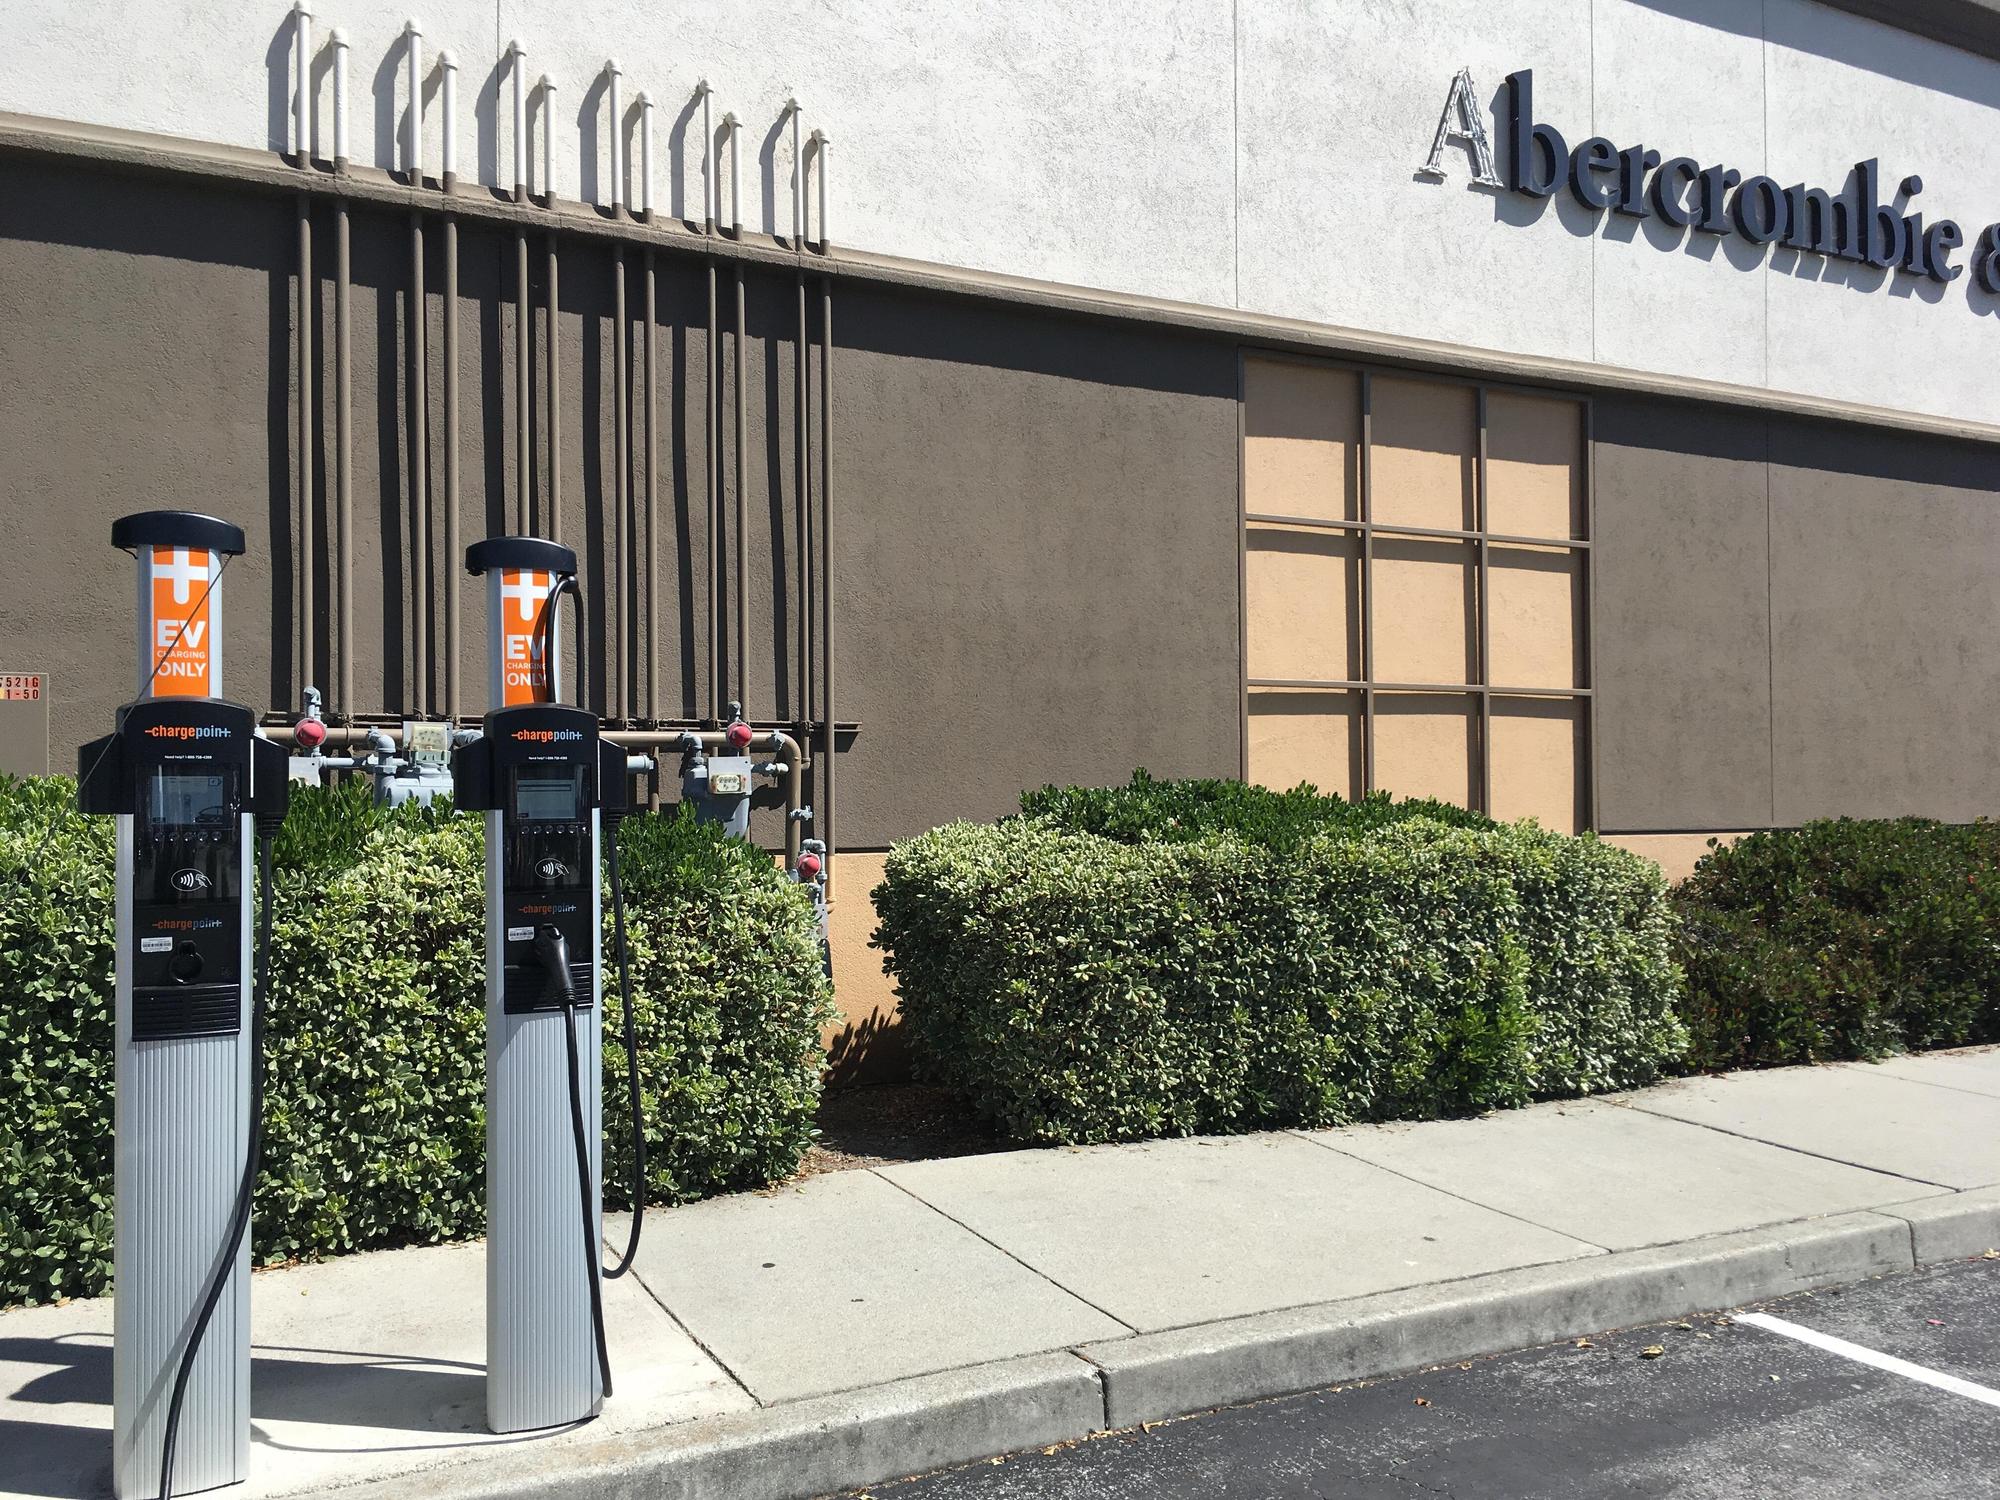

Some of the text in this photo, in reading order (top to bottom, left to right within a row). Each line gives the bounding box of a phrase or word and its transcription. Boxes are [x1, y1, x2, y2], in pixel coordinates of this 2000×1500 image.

[1418, 66, 1963, 282] Abercrombie
[157, 619, 206, 648] EV
[157, 650, 205, 659] CHARGING
[506, 635, 546, 659] EV
[157, 662, 206, 677] ONLY
[7, 689, 39, 699] 1-50
